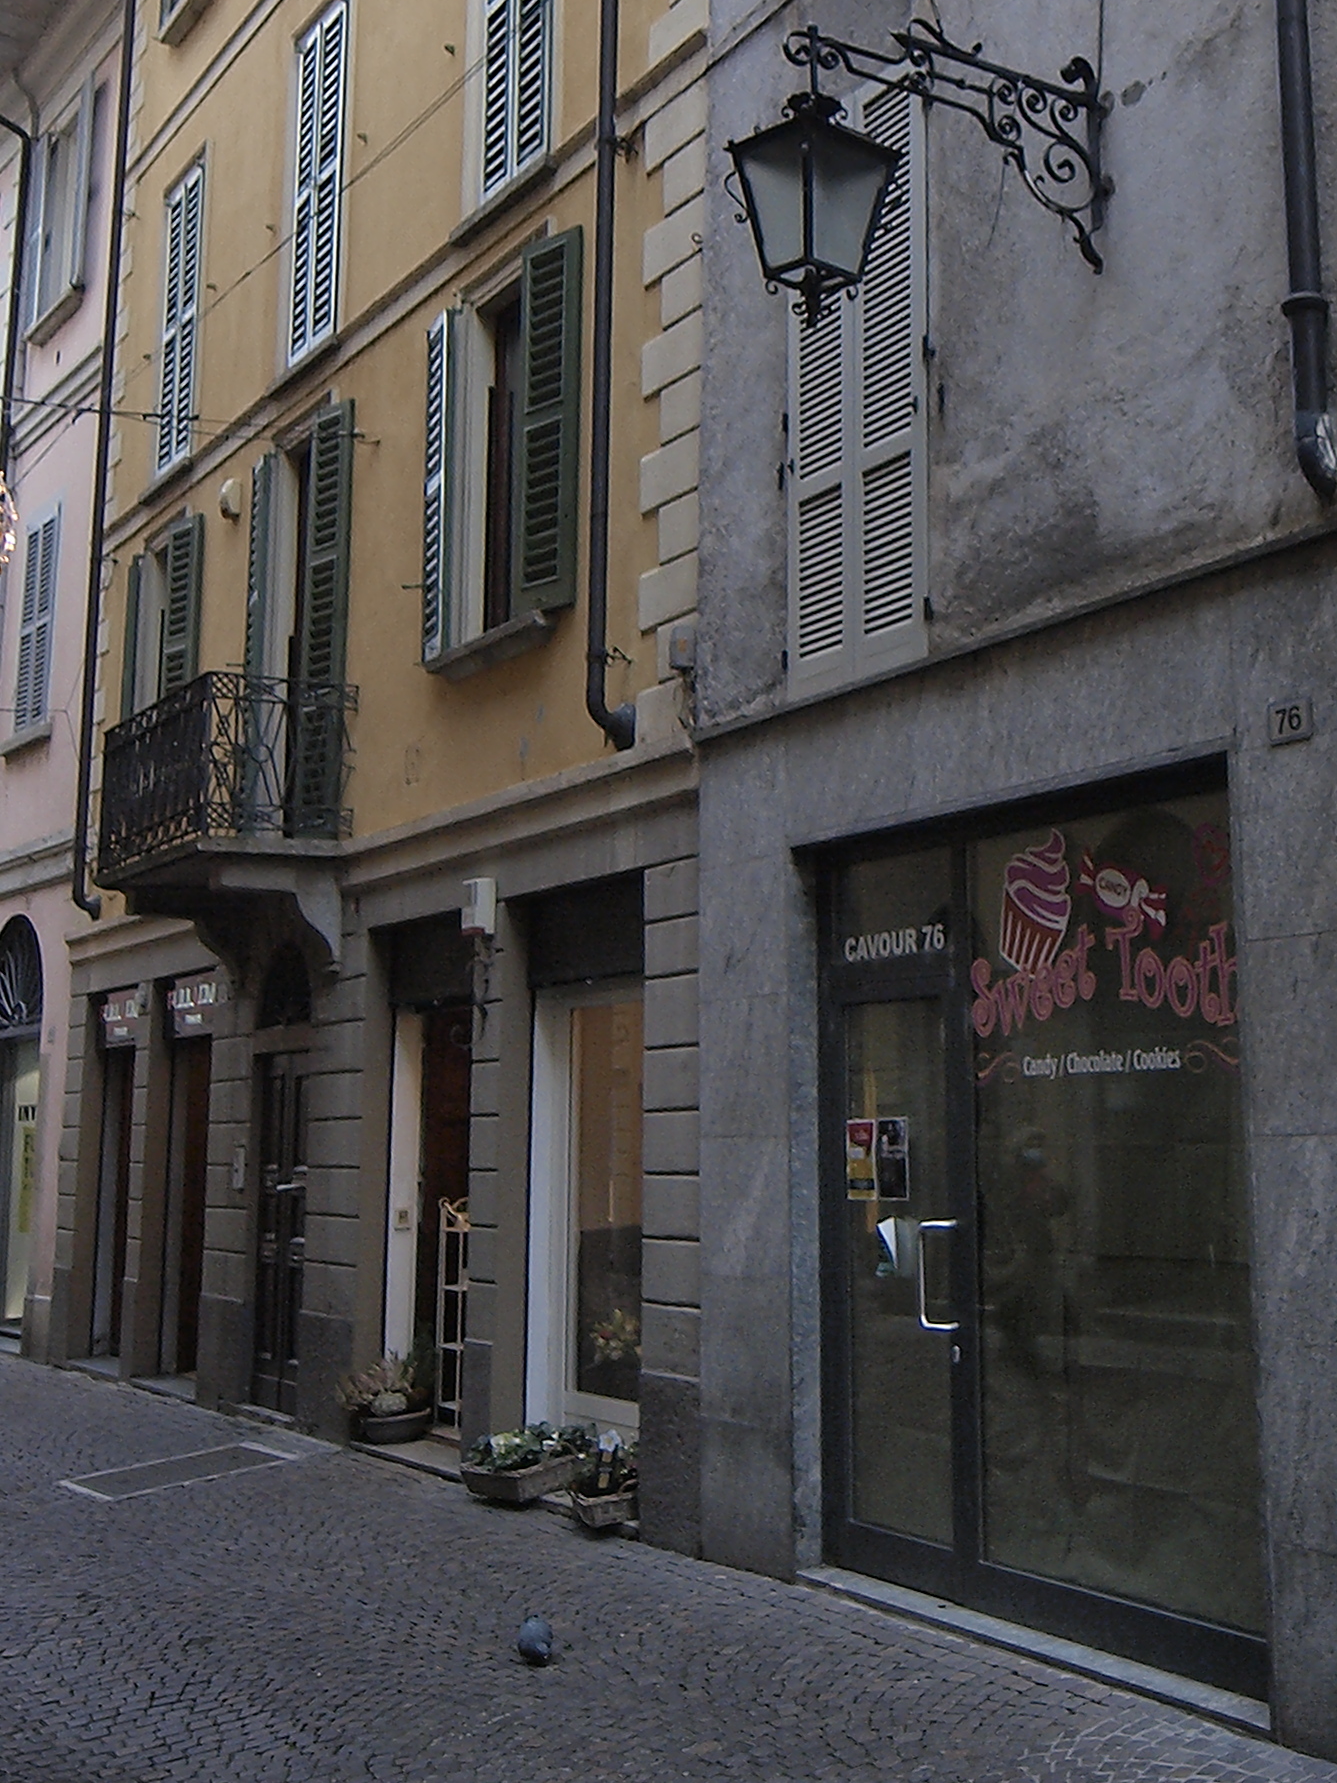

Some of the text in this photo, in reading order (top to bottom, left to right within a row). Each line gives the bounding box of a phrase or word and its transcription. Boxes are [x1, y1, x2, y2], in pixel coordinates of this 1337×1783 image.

[1275, 704, 1302, 734] 76
[844, 922, 945, 962] CAVOUR 76
[970, 923, 1097, 1037] Sweet
[1023, 1053, 1058, 1080] Candy
[1066, 1049, 1124, 1075] Chocolate
[1133, 1046, 1181, 1071] Cookies
